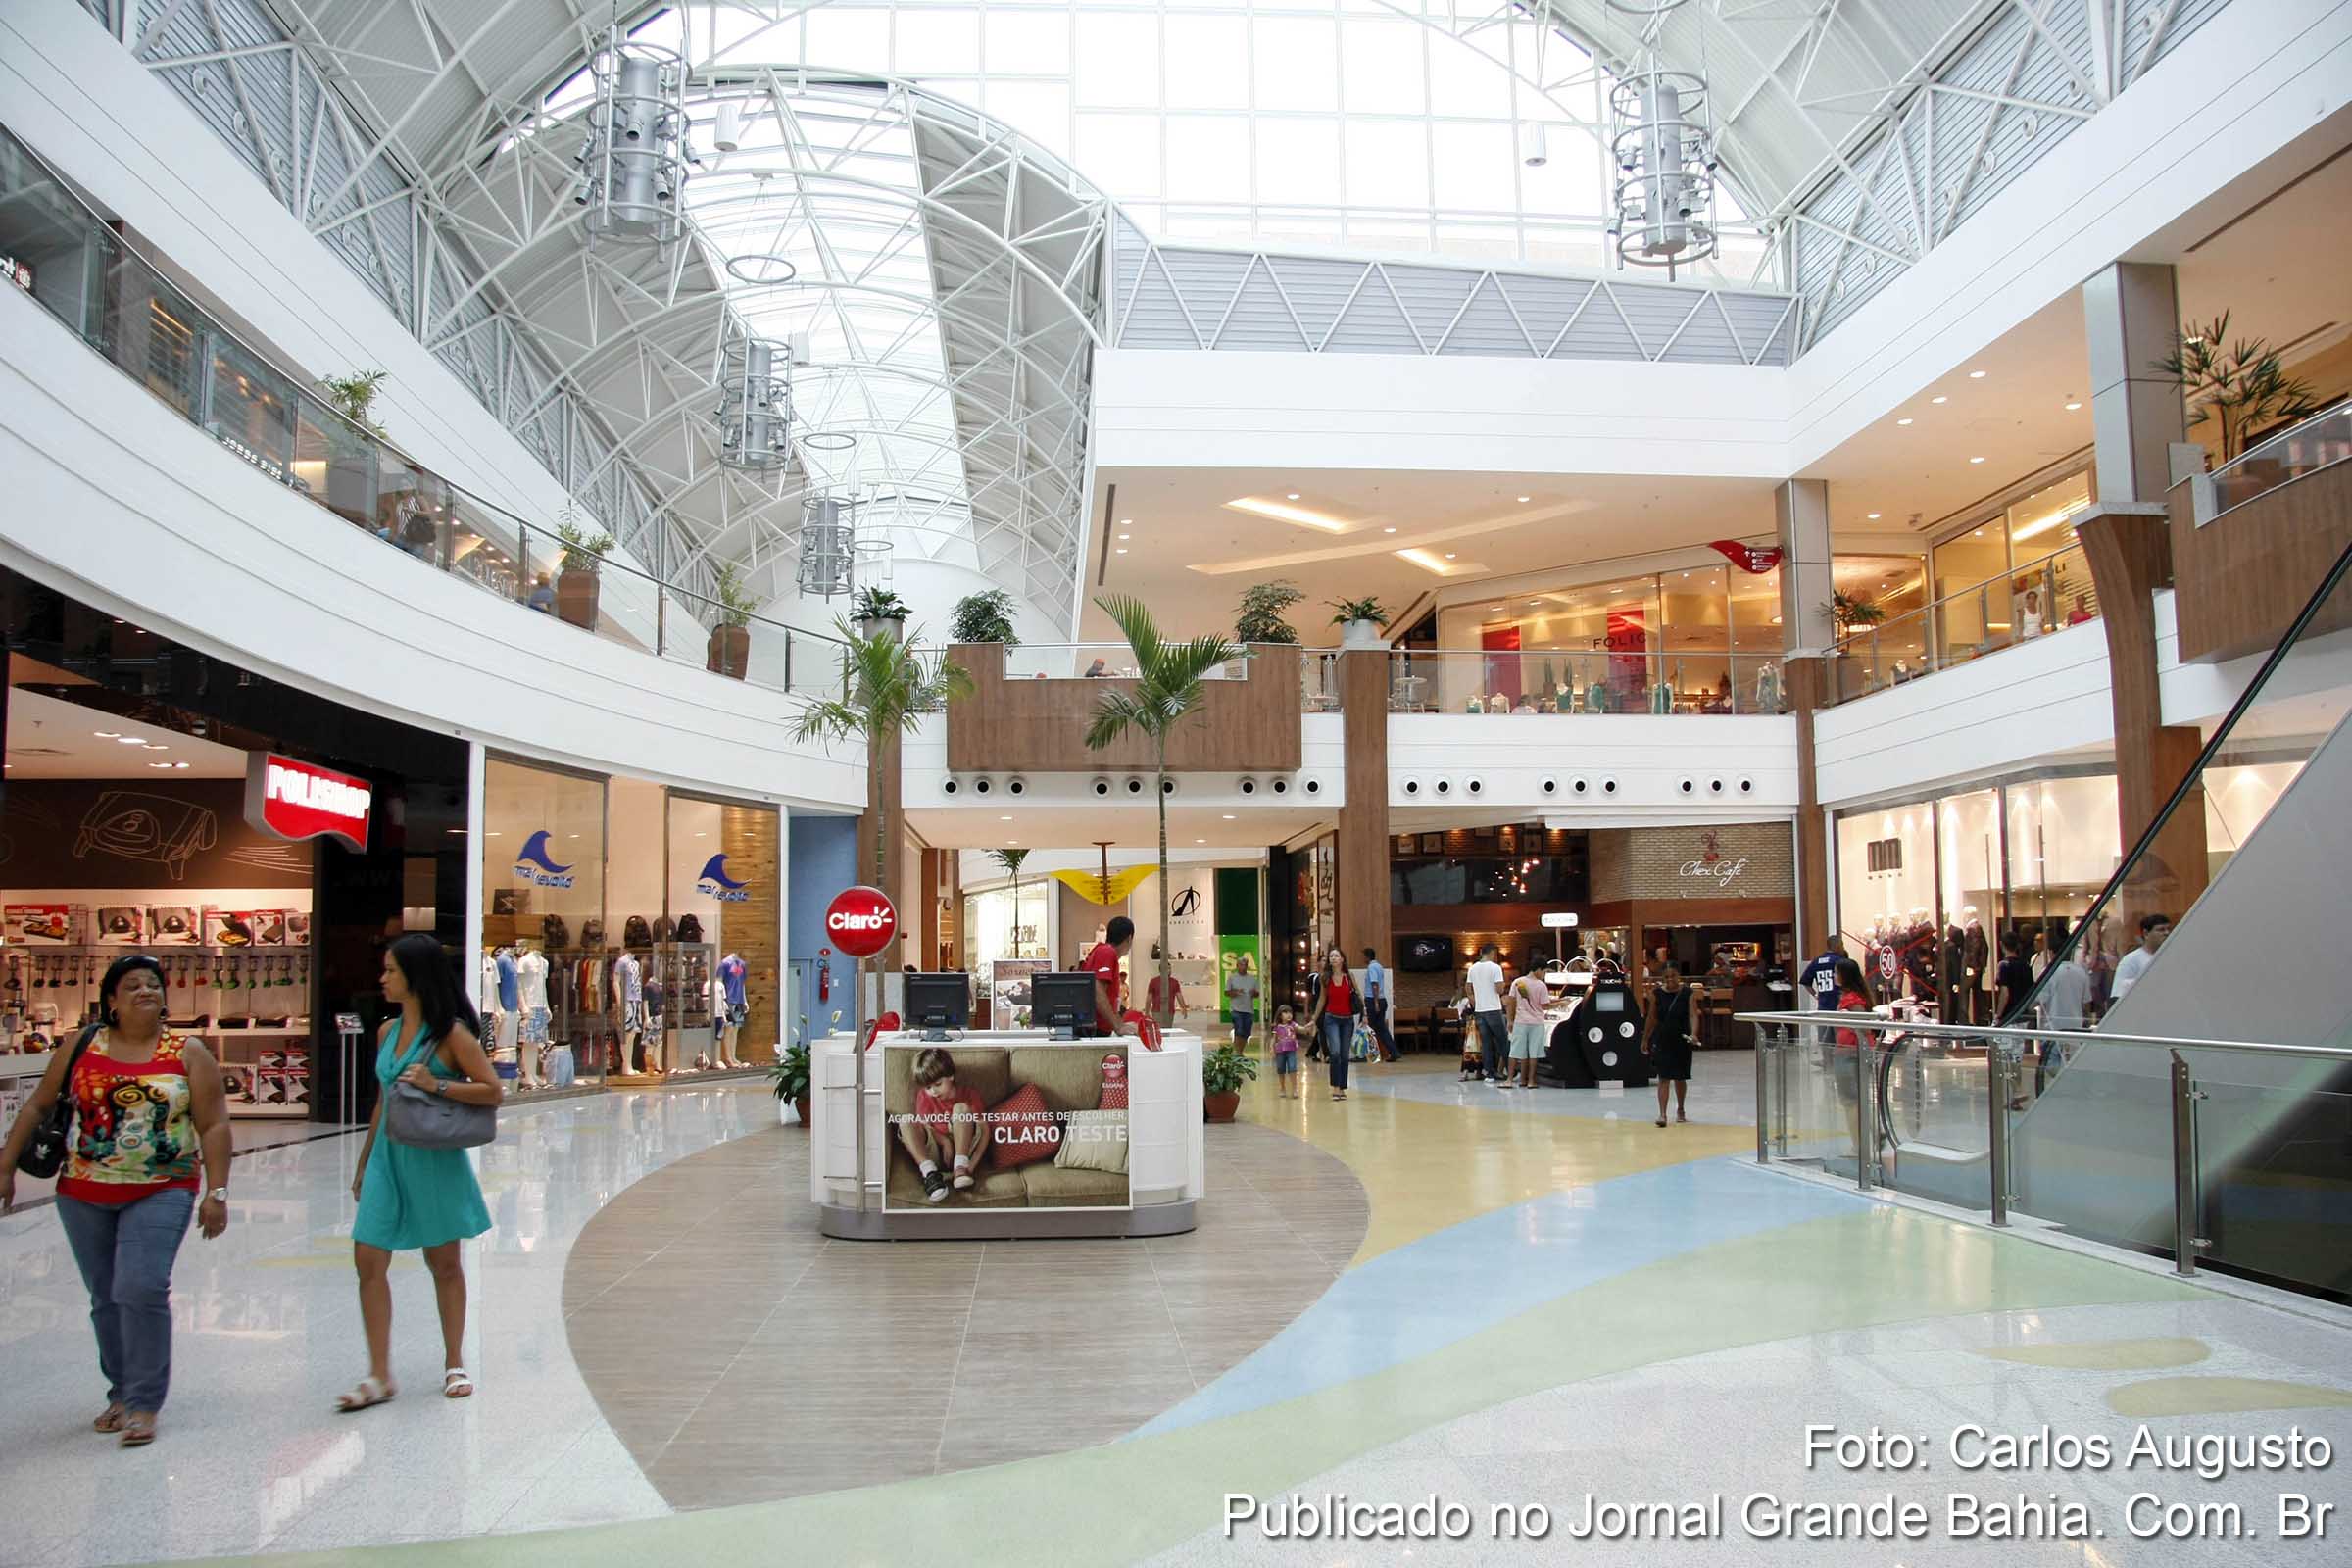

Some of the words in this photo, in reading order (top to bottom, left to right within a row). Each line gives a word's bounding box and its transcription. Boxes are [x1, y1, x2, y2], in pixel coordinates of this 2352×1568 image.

[829, 910, 884, 930] Claro
[1816, 969, 1835, 993] 55
[923, 1110, 950, 1123] VOCÊ
[952, 1113, 979, 1123] PODE
[981, 1112, 1019, 1123] TESTAR
[1020, 1111, 1054, 1122] ANTES
[1056, 1111, 1070, 1121] DE
[994, 1125, 1060, 1144] CLARO
[1065, 1124, 1128, 1143] TESTE
